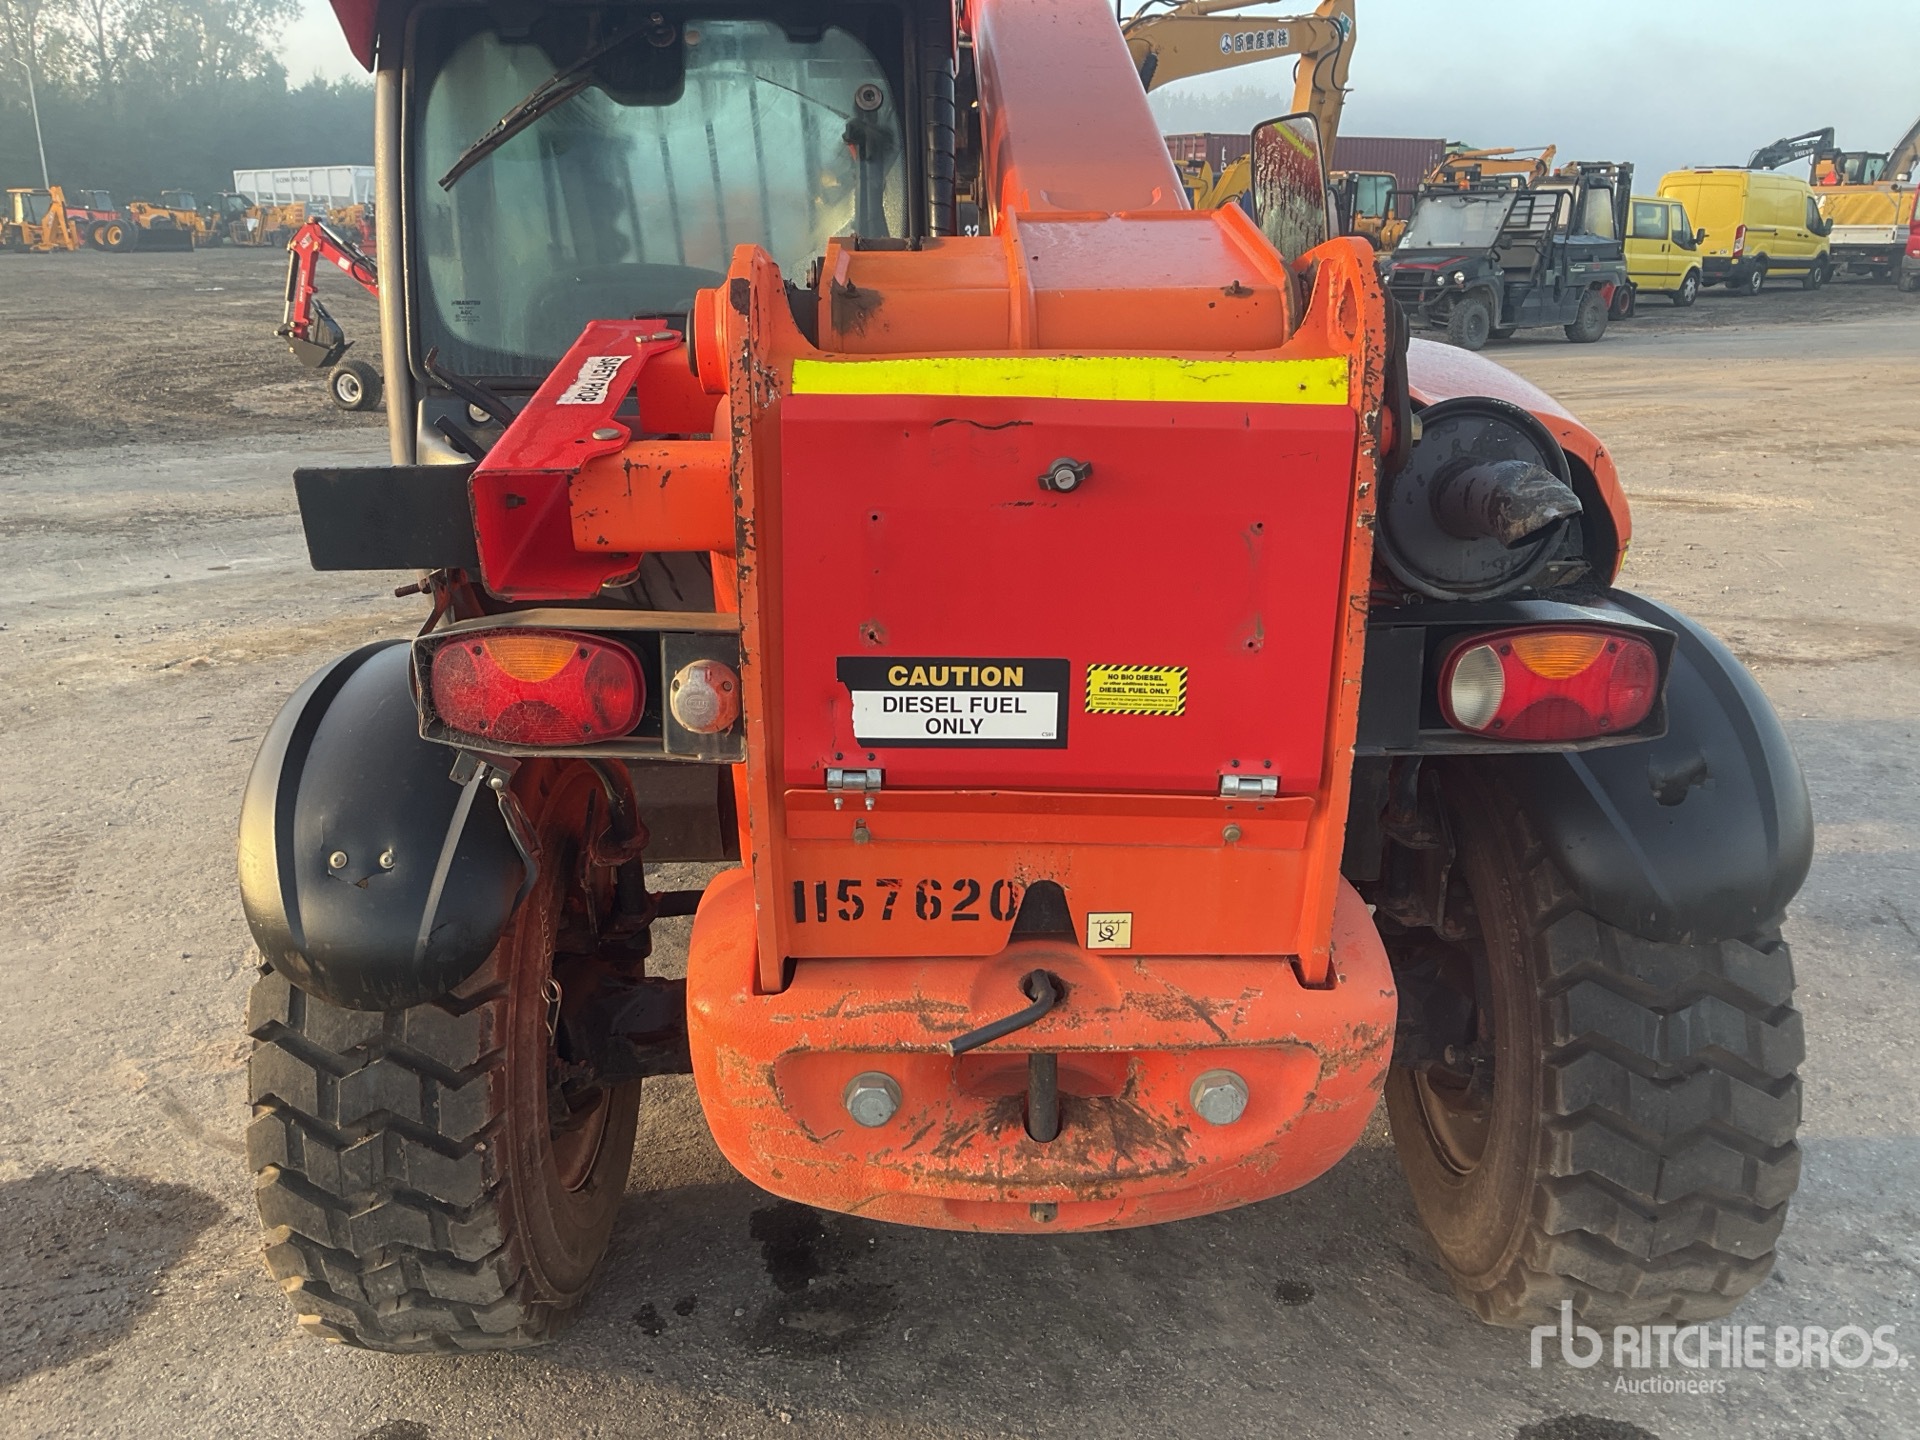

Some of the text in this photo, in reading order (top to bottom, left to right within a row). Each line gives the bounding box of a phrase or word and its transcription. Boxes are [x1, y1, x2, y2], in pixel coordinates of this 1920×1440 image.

[574, 357, 622, 402] SAFETY PROP
[888, 665, 1024, 687] CAUTION
[883, 696, 1027, 713] DIESEL FUEL
[925, 717, 984, 735] ONLY
[793, 878, 1018, 923] 1157620
